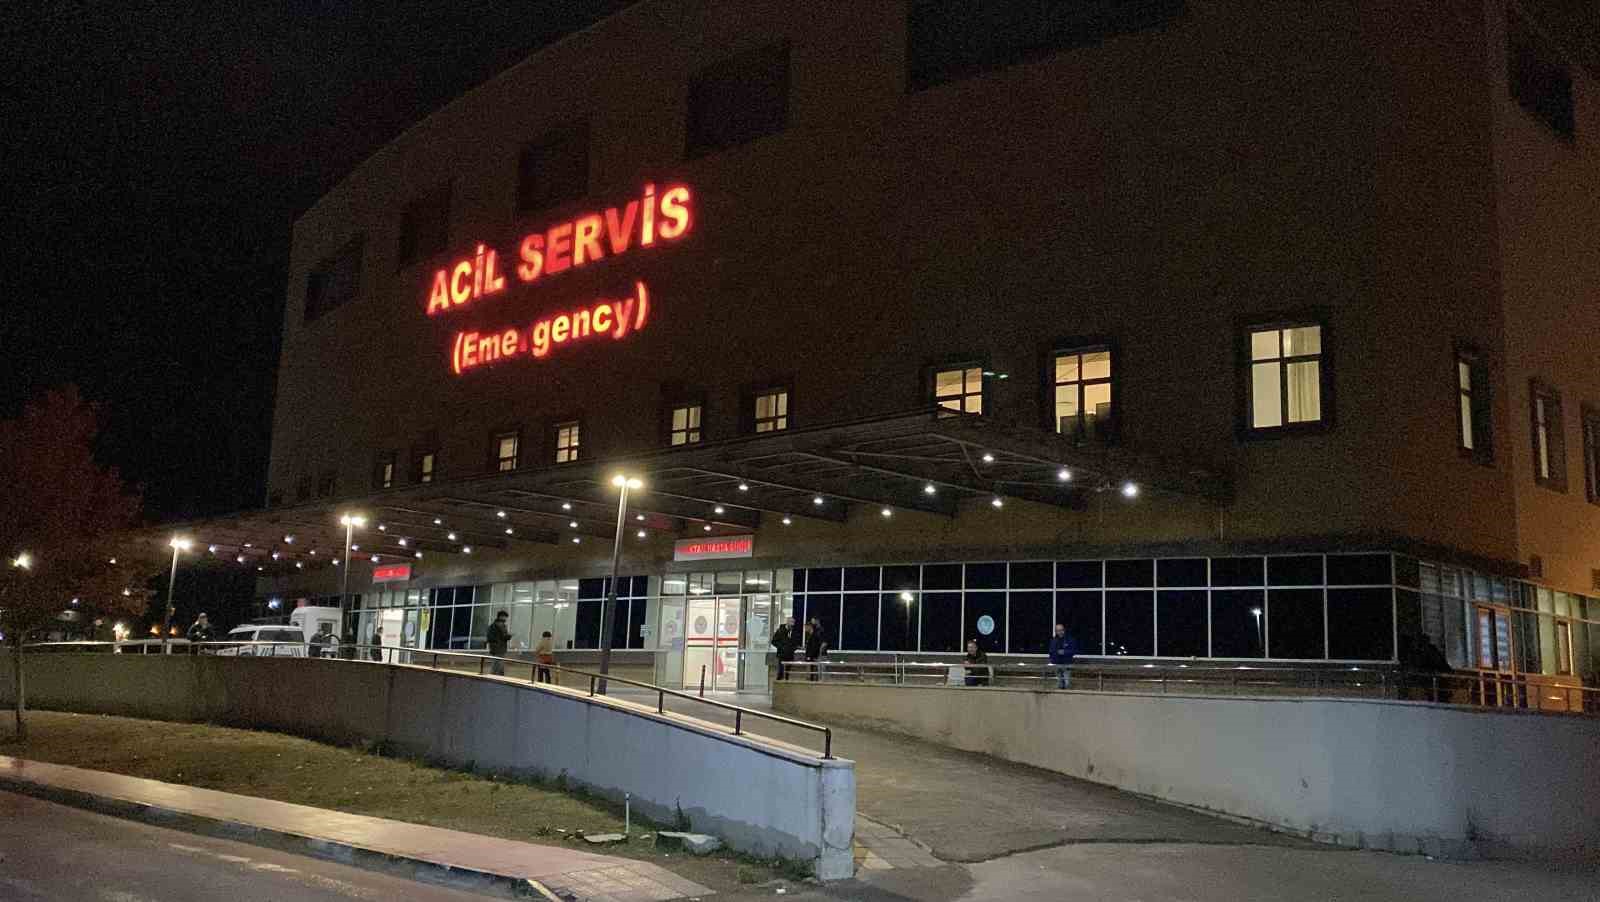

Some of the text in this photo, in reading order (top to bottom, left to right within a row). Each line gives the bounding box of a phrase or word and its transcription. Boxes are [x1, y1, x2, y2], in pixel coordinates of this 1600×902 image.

[426, 184, 691, 315] ACİL SERVİS
[453, 281, 648, 374] (Emegency)
